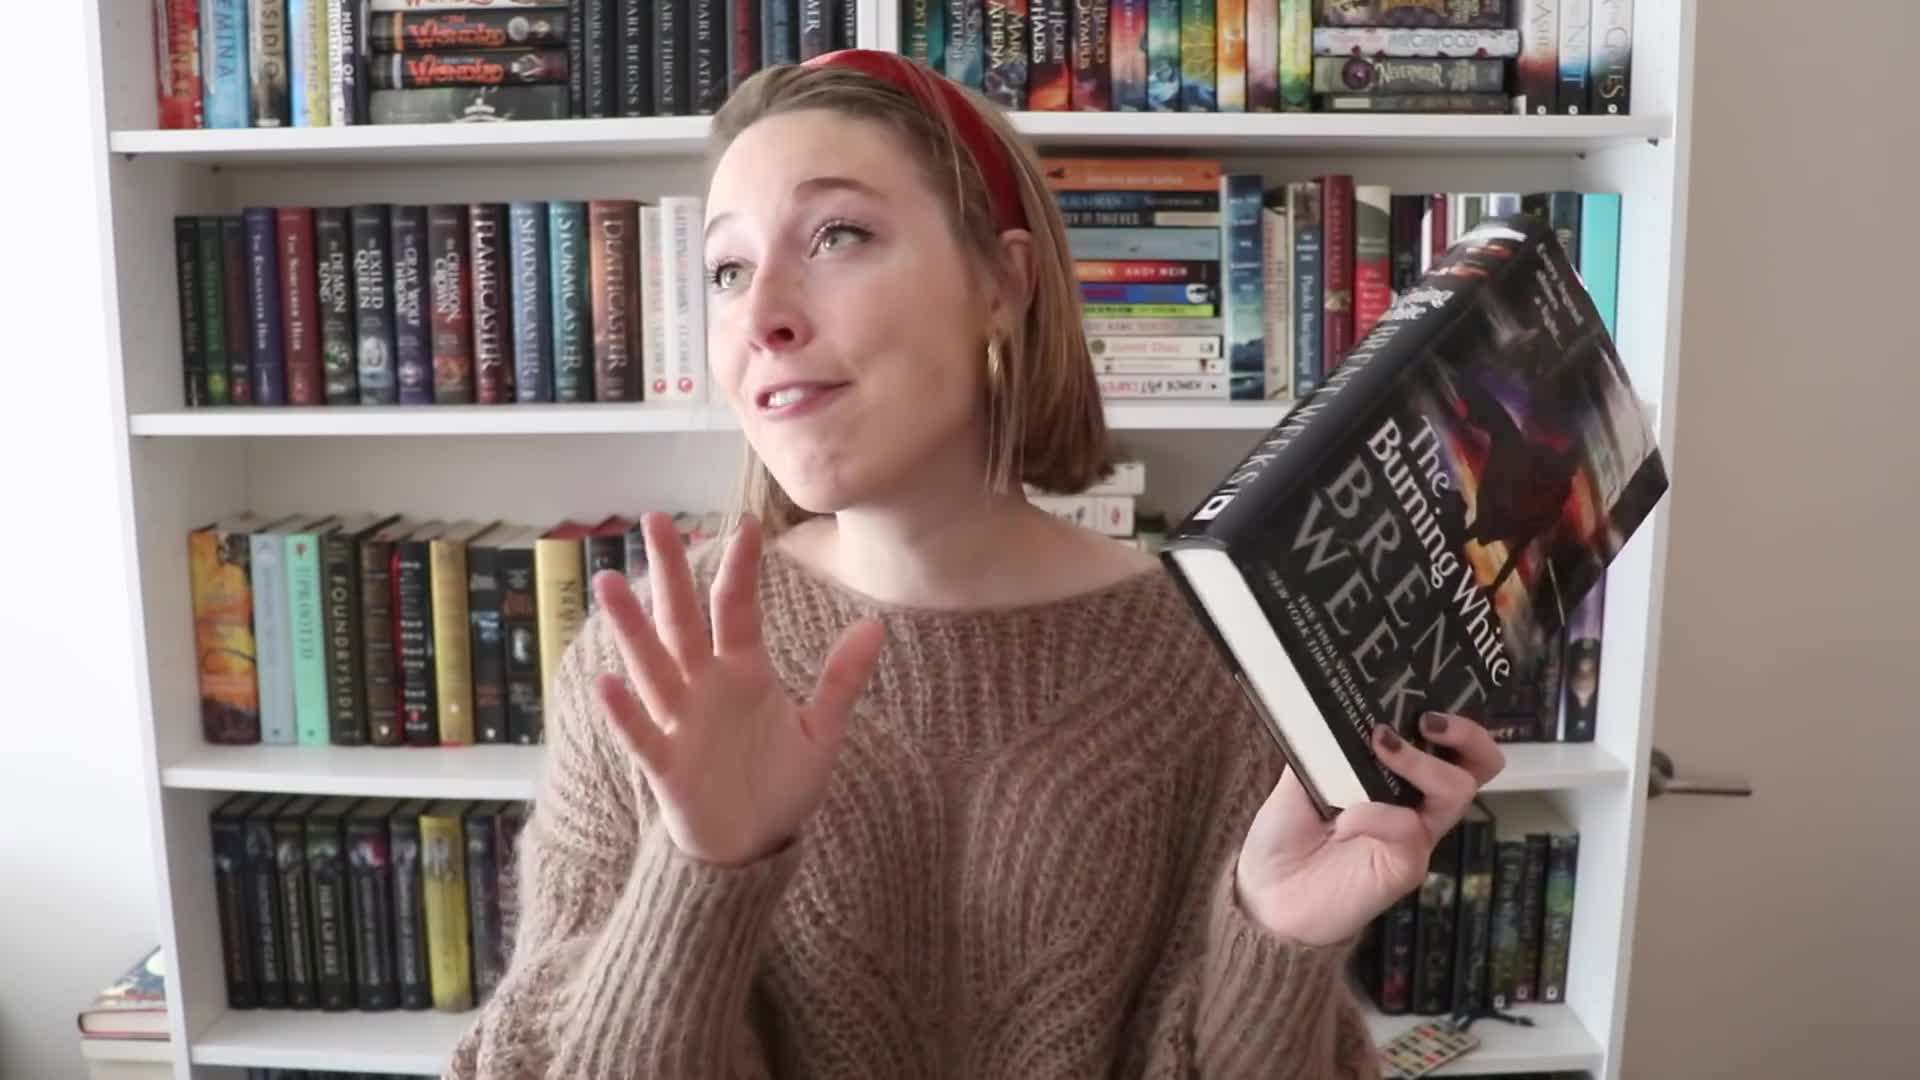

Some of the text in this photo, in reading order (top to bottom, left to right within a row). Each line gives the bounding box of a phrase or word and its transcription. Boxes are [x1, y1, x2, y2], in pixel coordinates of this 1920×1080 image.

[342, 11, 355, 86] MUSE OF
[989, 1, 1005, 70] ATHENA
[1030, 7, 1047, 64] HADES
[1076, 0, 1093, 70] OLYMPUS
[319, 262, 332, 303] KING
[332, 253, 346, 313] DEMON
[355, 249, 370, 309] QUEEN
[370, 249, 384, 309] EXILED
[433, 258, 447, 313] CROWN
[445, 252, 462, 323] CRIMSON
[518, 218, 540, 377] SHADOWCASTER
[556, 217, 582, 372] STORMCASTER
[601, 219, 628, 371] DEATHCASTER
[1227, 325, 1402, 484] BRENT WEEKS
[1408, 415, 1450, 498] The
[1325, 454, 1487, 715] BRENT
[1366, 417, 1512, 687] Burning White
[1292, 495, 1427, 734] WEEK
[1298, 593, 1316, 620] THE
[331, 575, 354, 721] FOUNDRYSIDE
[1329, 674, 1375, 748] BESTSELLIN
